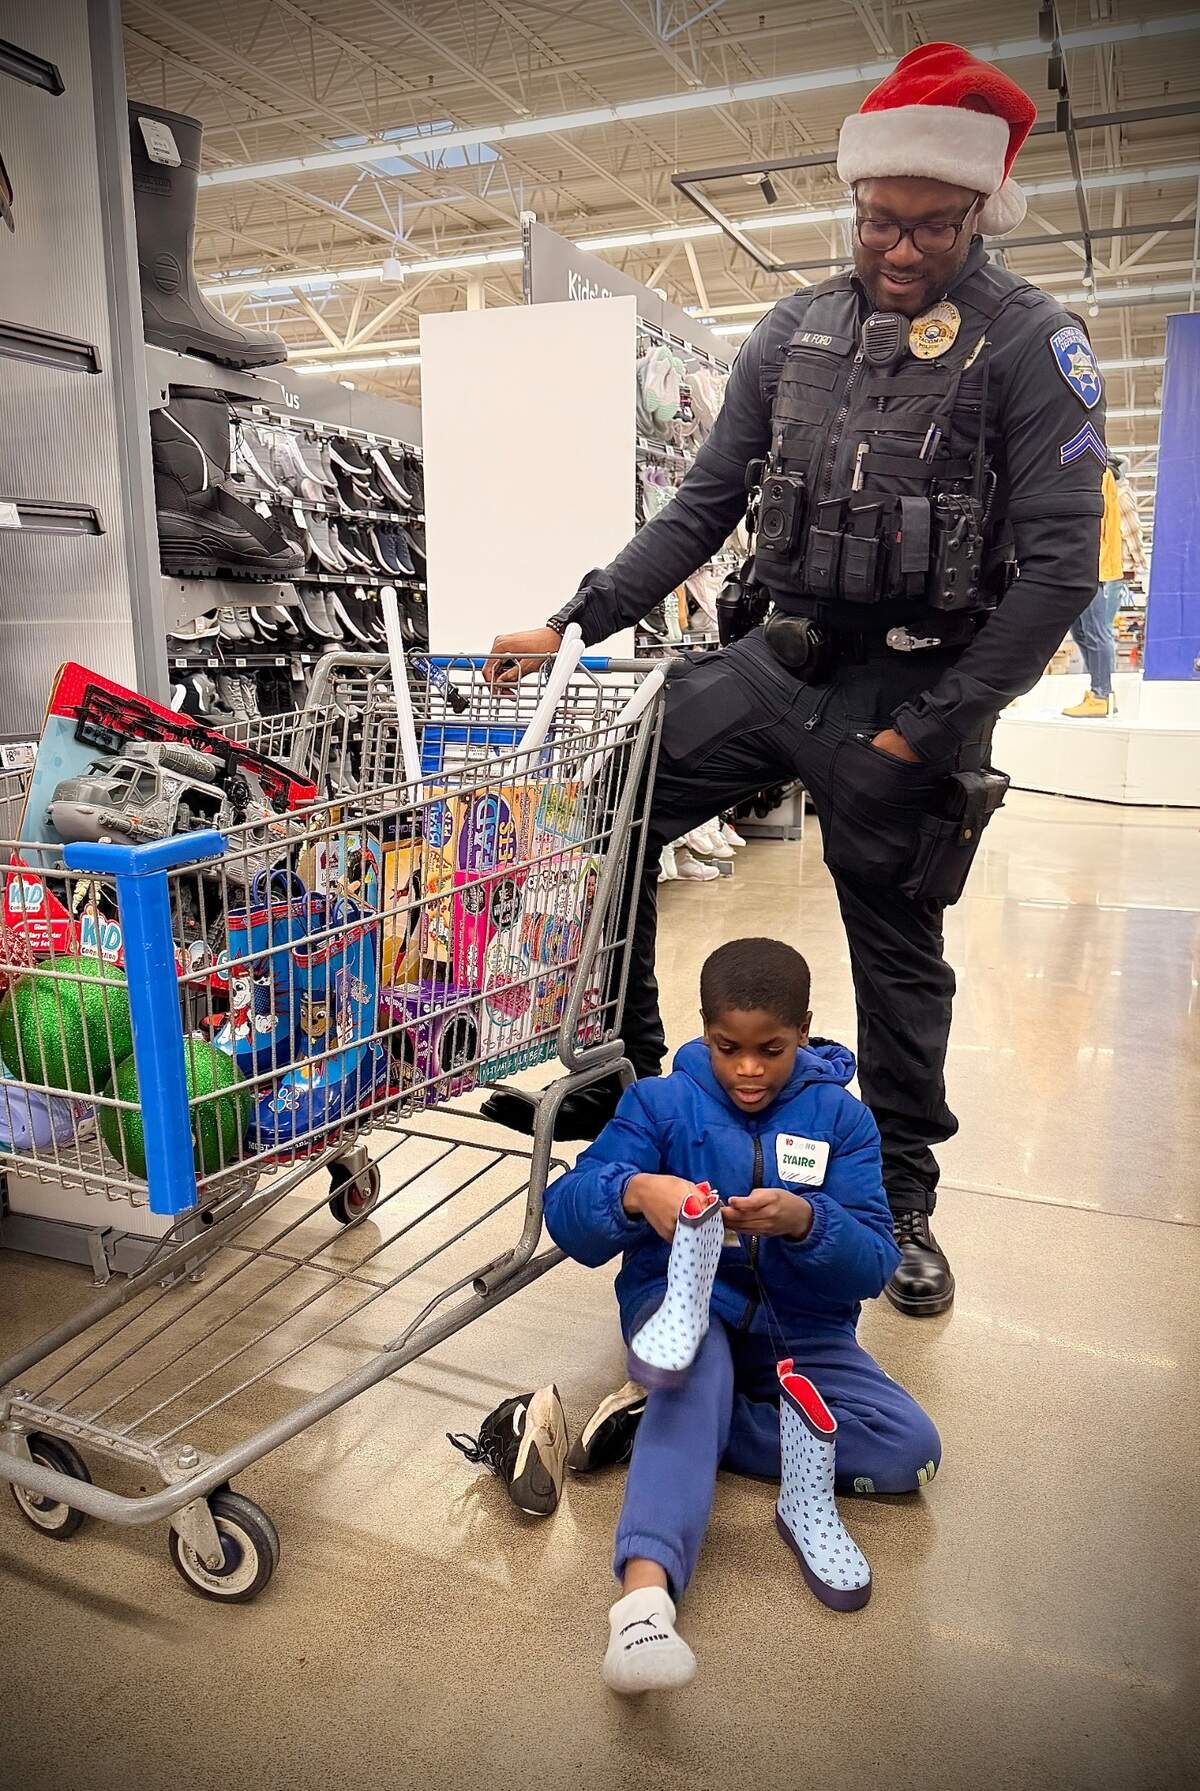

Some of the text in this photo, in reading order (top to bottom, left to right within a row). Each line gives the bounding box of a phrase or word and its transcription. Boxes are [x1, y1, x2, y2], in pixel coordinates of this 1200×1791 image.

[811, 334, 832, 346] FORD
[473, 798, 496, 869] EAD
[498, 821, 514, 861] ETS
[82, 917, 121, 951] KID
